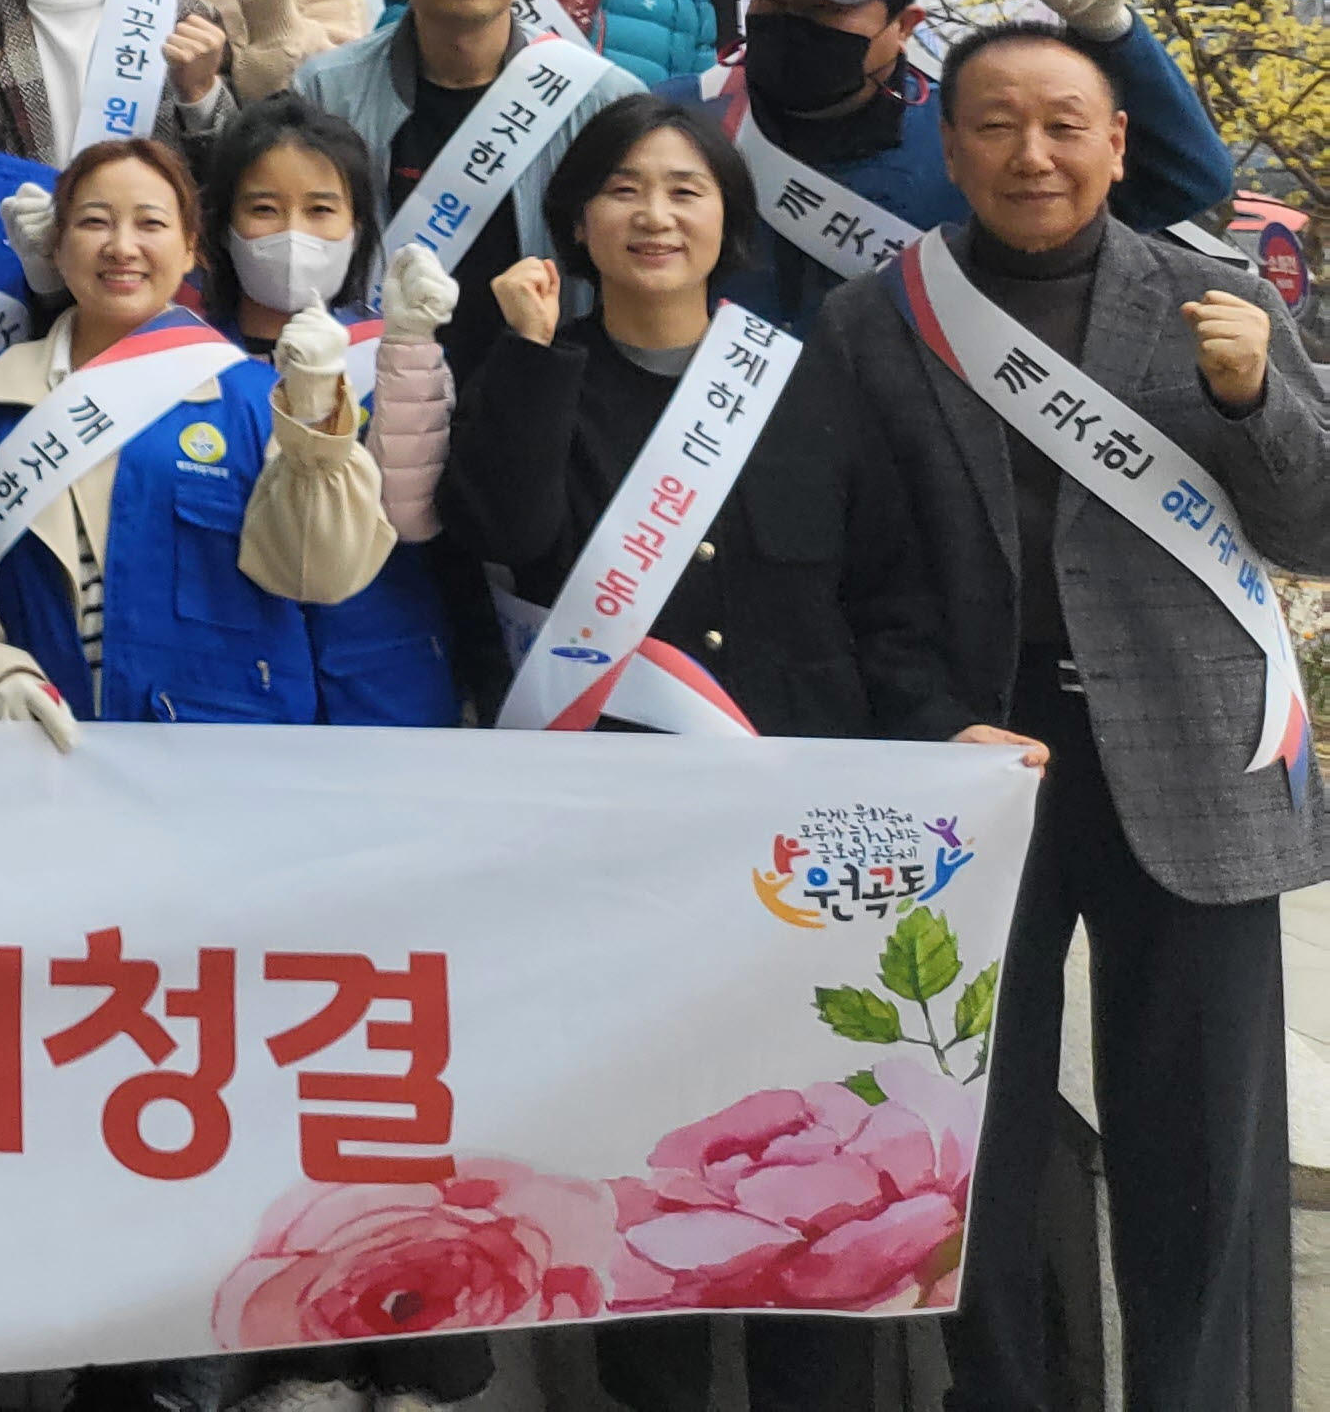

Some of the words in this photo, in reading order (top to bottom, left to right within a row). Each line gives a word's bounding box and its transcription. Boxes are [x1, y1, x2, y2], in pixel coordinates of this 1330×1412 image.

[463, 64, 572, 185] 깨끗한
[414, 191, 471, 252] 원
[683, 315, 780, 468] 함께하는
[995, 348, 1155, 481] 깨끗한
[1161, 478, 1267, 605] 원곡동
[594, 475, 695, 616] 원곡동
[799, 824, 843, 839] 모두가
[850, 825, 921, 844] 하나되는
[816, 843, 868, 867] 글로벌
[870, 845, 918, 865] 공동체
[803, 863, 927, 921] 원곡동
